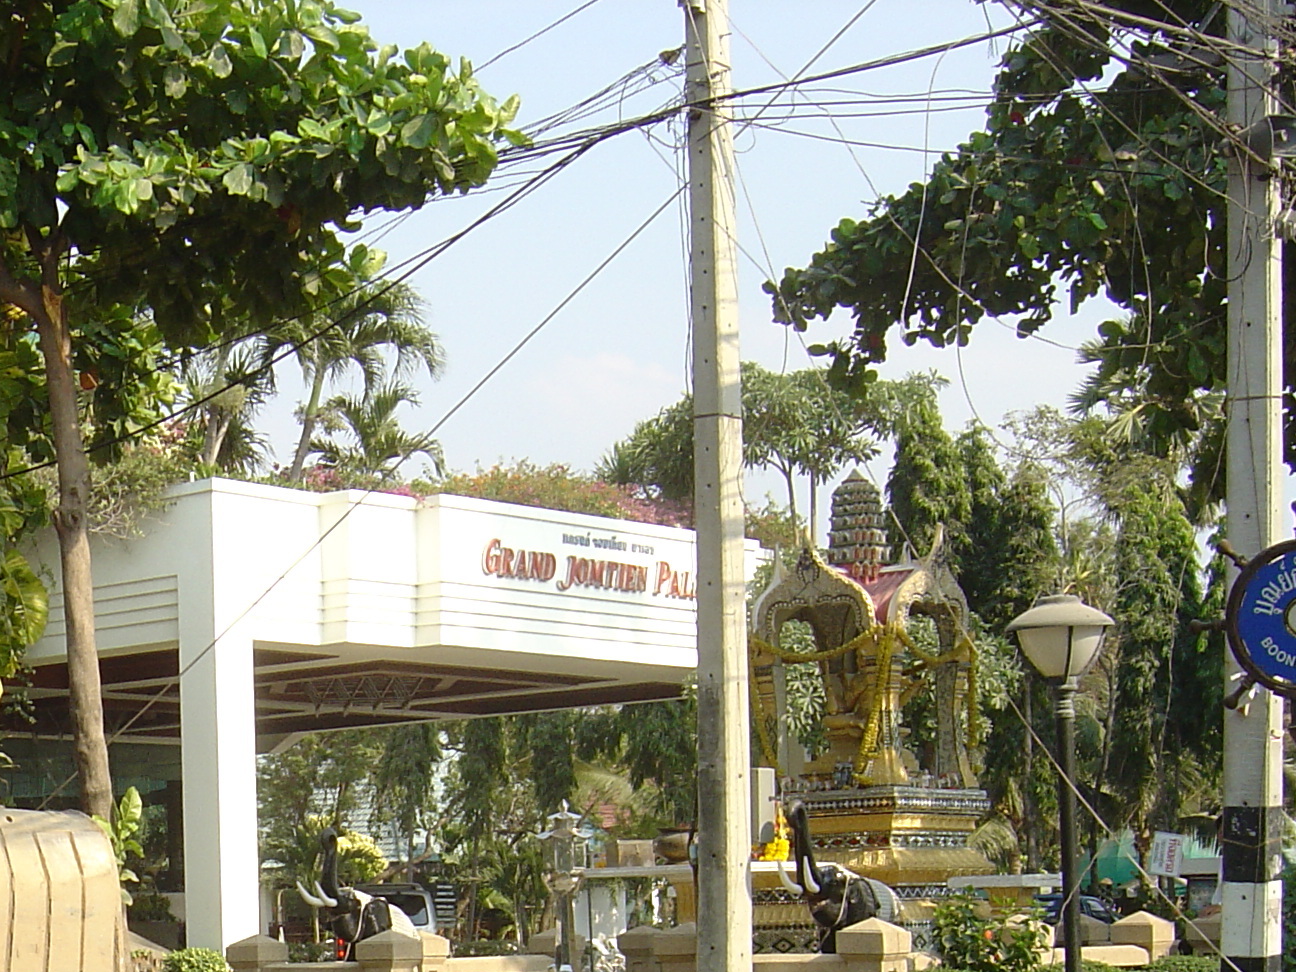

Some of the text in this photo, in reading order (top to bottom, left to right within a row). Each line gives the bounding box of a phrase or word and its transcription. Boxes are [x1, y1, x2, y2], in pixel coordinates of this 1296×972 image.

[481, 537, 697, 600] GRAND JOMTIEN PAL
